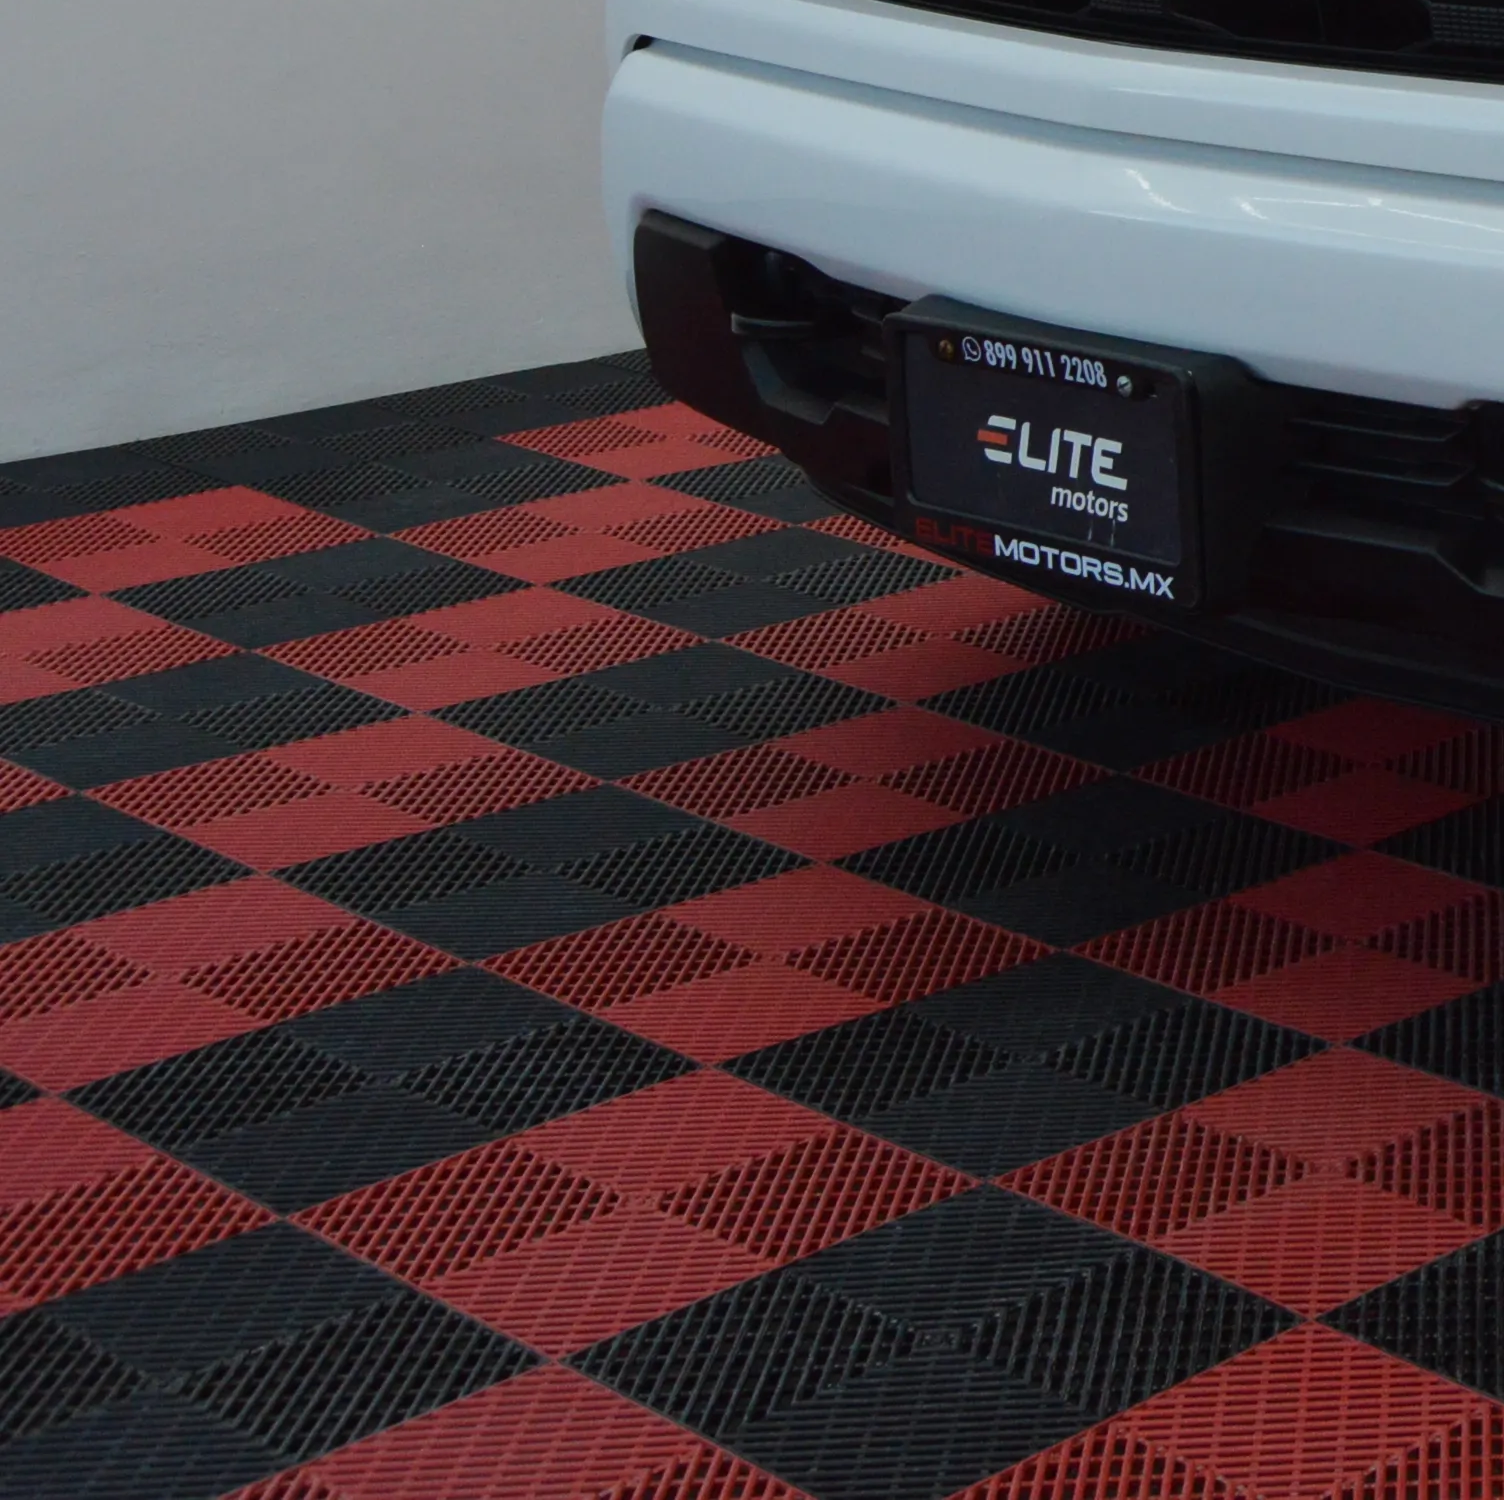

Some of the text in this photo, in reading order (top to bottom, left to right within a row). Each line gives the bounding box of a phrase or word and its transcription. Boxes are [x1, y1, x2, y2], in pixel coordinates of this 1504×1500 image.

[983, 339, 1108, 389] 899 911 2208
[976, 414, 1129, 491] ELITE
[1050, 485, 1129, 523] motors
